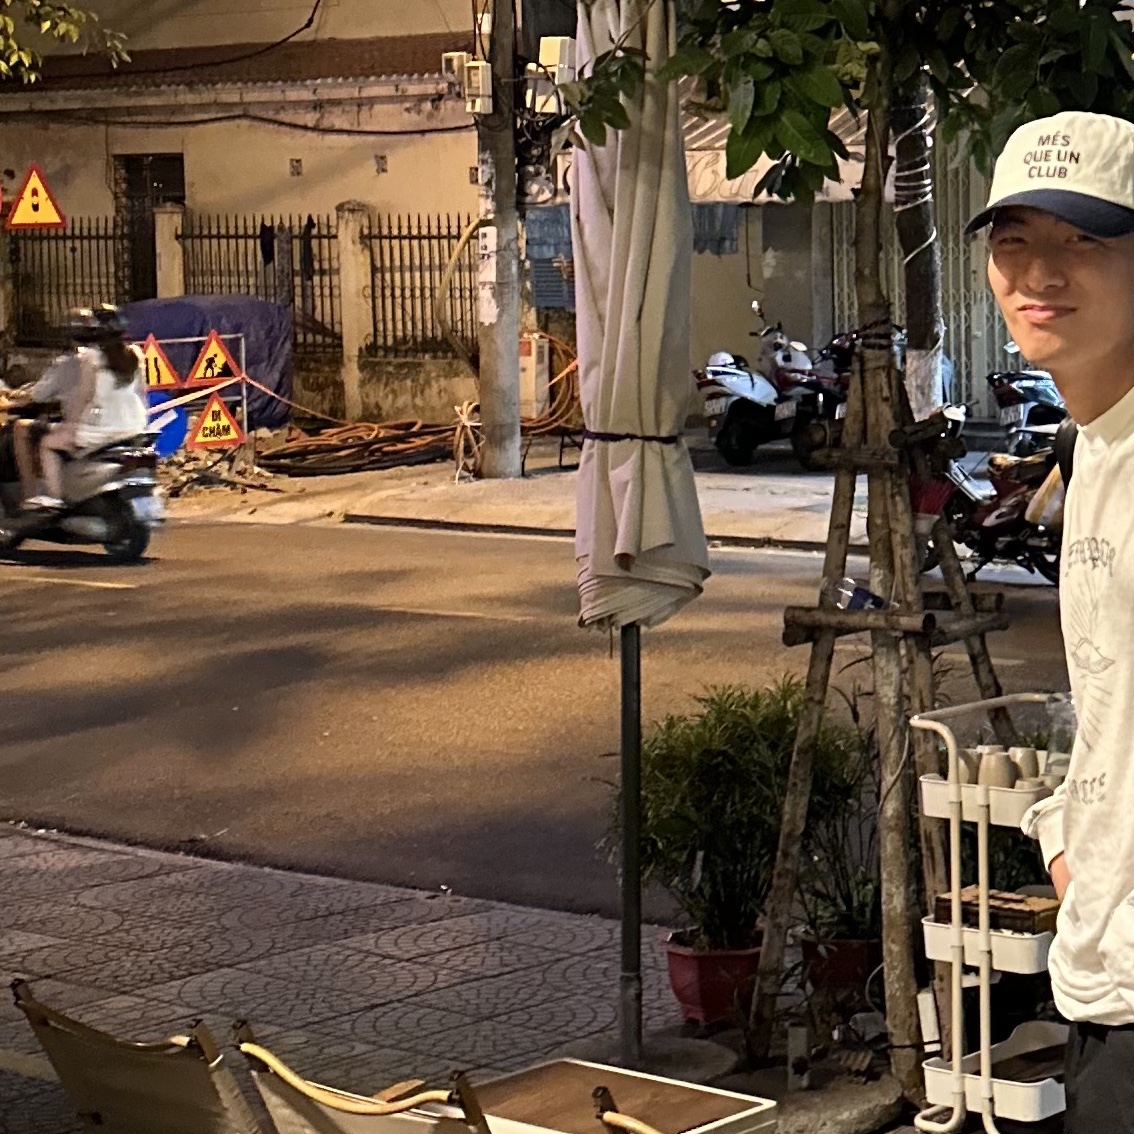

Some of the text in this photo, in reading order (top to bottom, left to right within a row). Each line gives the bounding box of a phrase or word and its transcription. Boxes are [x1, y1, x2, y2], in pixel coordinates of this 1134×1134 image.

[1037, 130, 1071, 147] MÉS
[1023, 149, 1081, 165] QUE UN
[1028, 165, 1068, 179] CLUB
